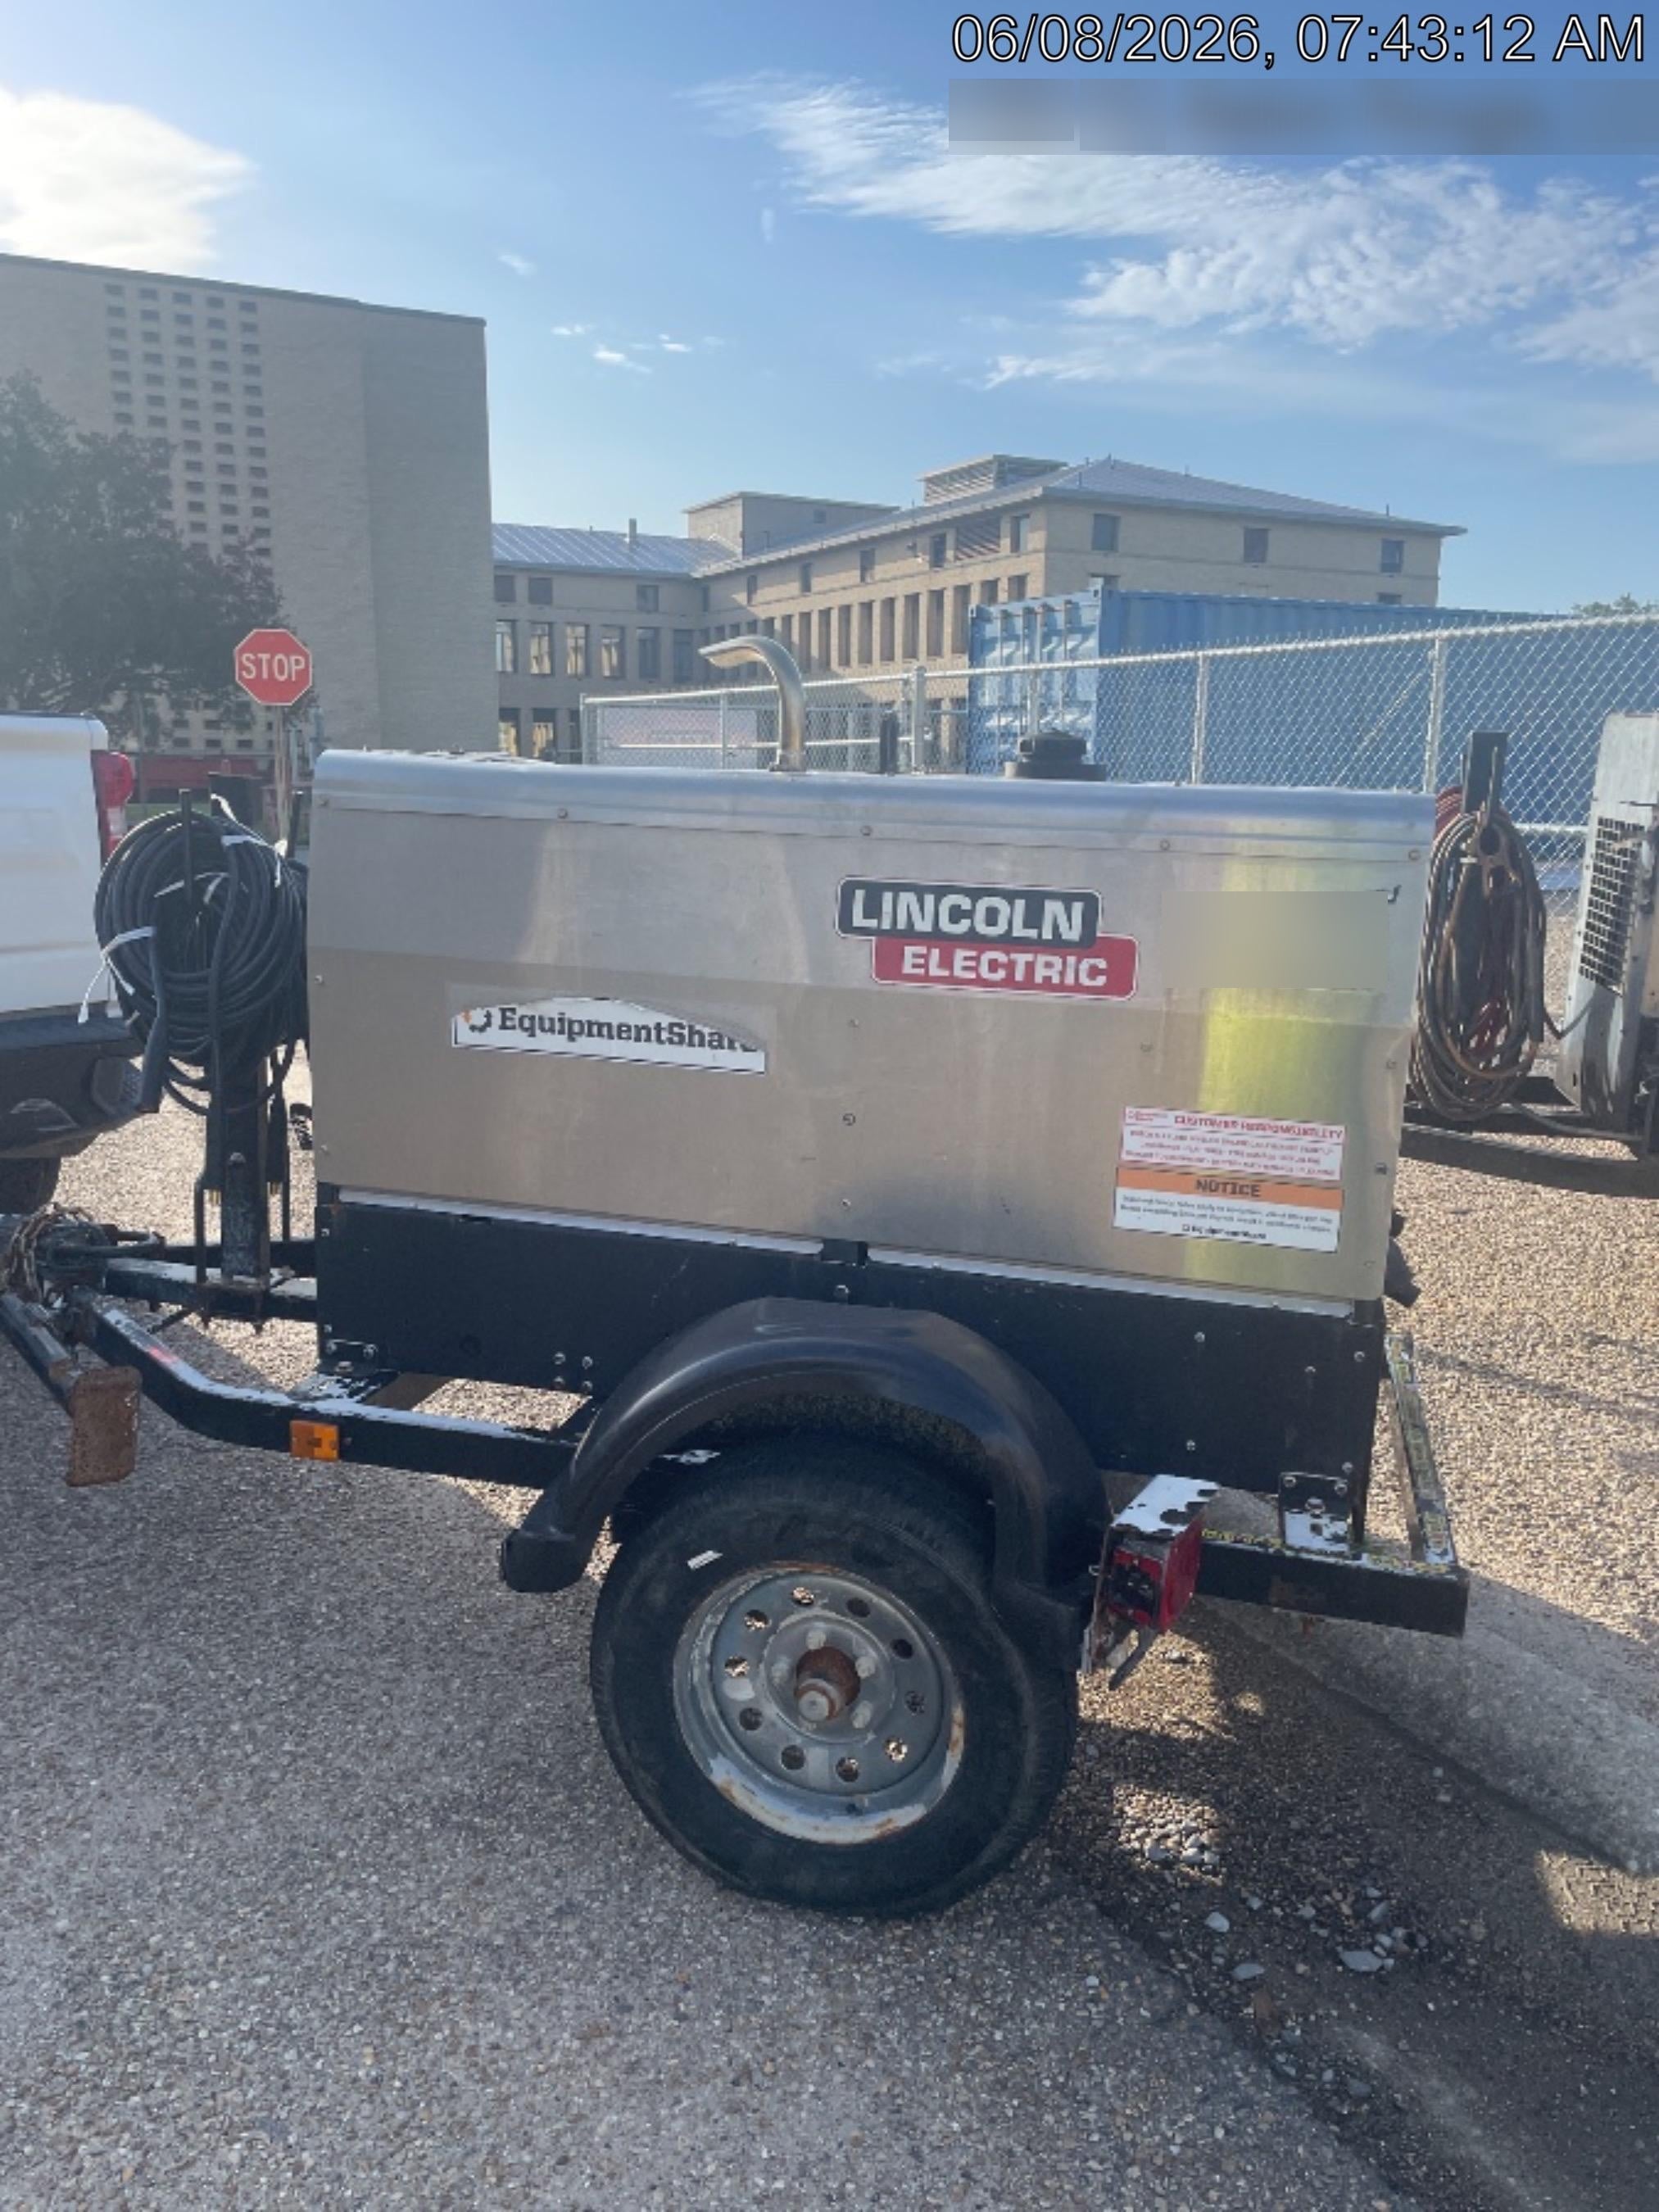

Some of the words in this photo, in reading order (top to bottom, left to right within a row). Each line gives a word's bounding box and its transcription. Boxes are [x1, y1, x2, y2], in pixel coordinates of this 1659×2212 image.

[241, 653, 306, 682] STOP
[852, 889, 1085, 942] LINCOLN
[902, 945, 1108, 986] ELECTRIC
[1195, 1179, 1262, 1198] NOTICE
